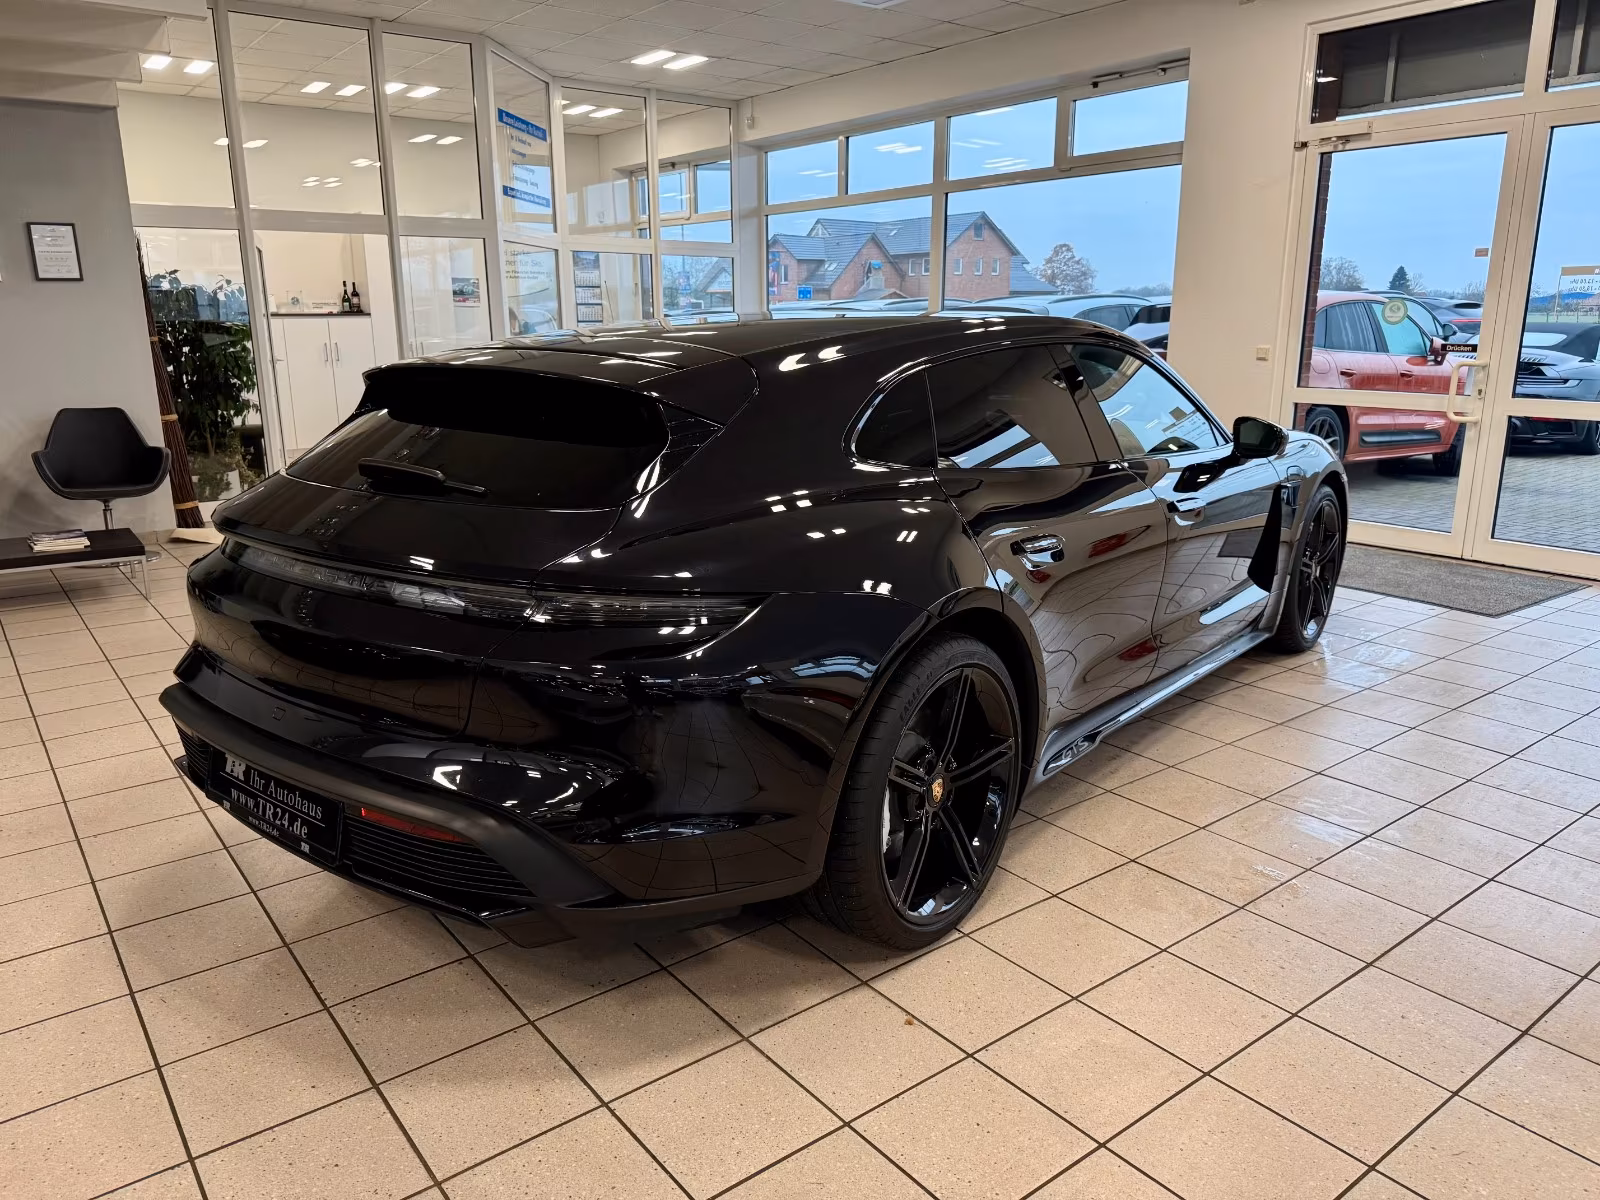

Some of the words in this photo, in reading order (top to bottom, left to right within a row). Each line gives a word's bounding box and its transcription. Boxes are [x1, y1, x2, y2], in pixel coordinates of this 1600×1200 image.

[1446, 344, 1473, 352] Drücken
[249, 769, 265, 791] Ihr
[267, 780, 322, 819] Autohaus
[230, 788, 308, 838] www.TR24.de
[248, 816, 279, 837] www.TR24.de
